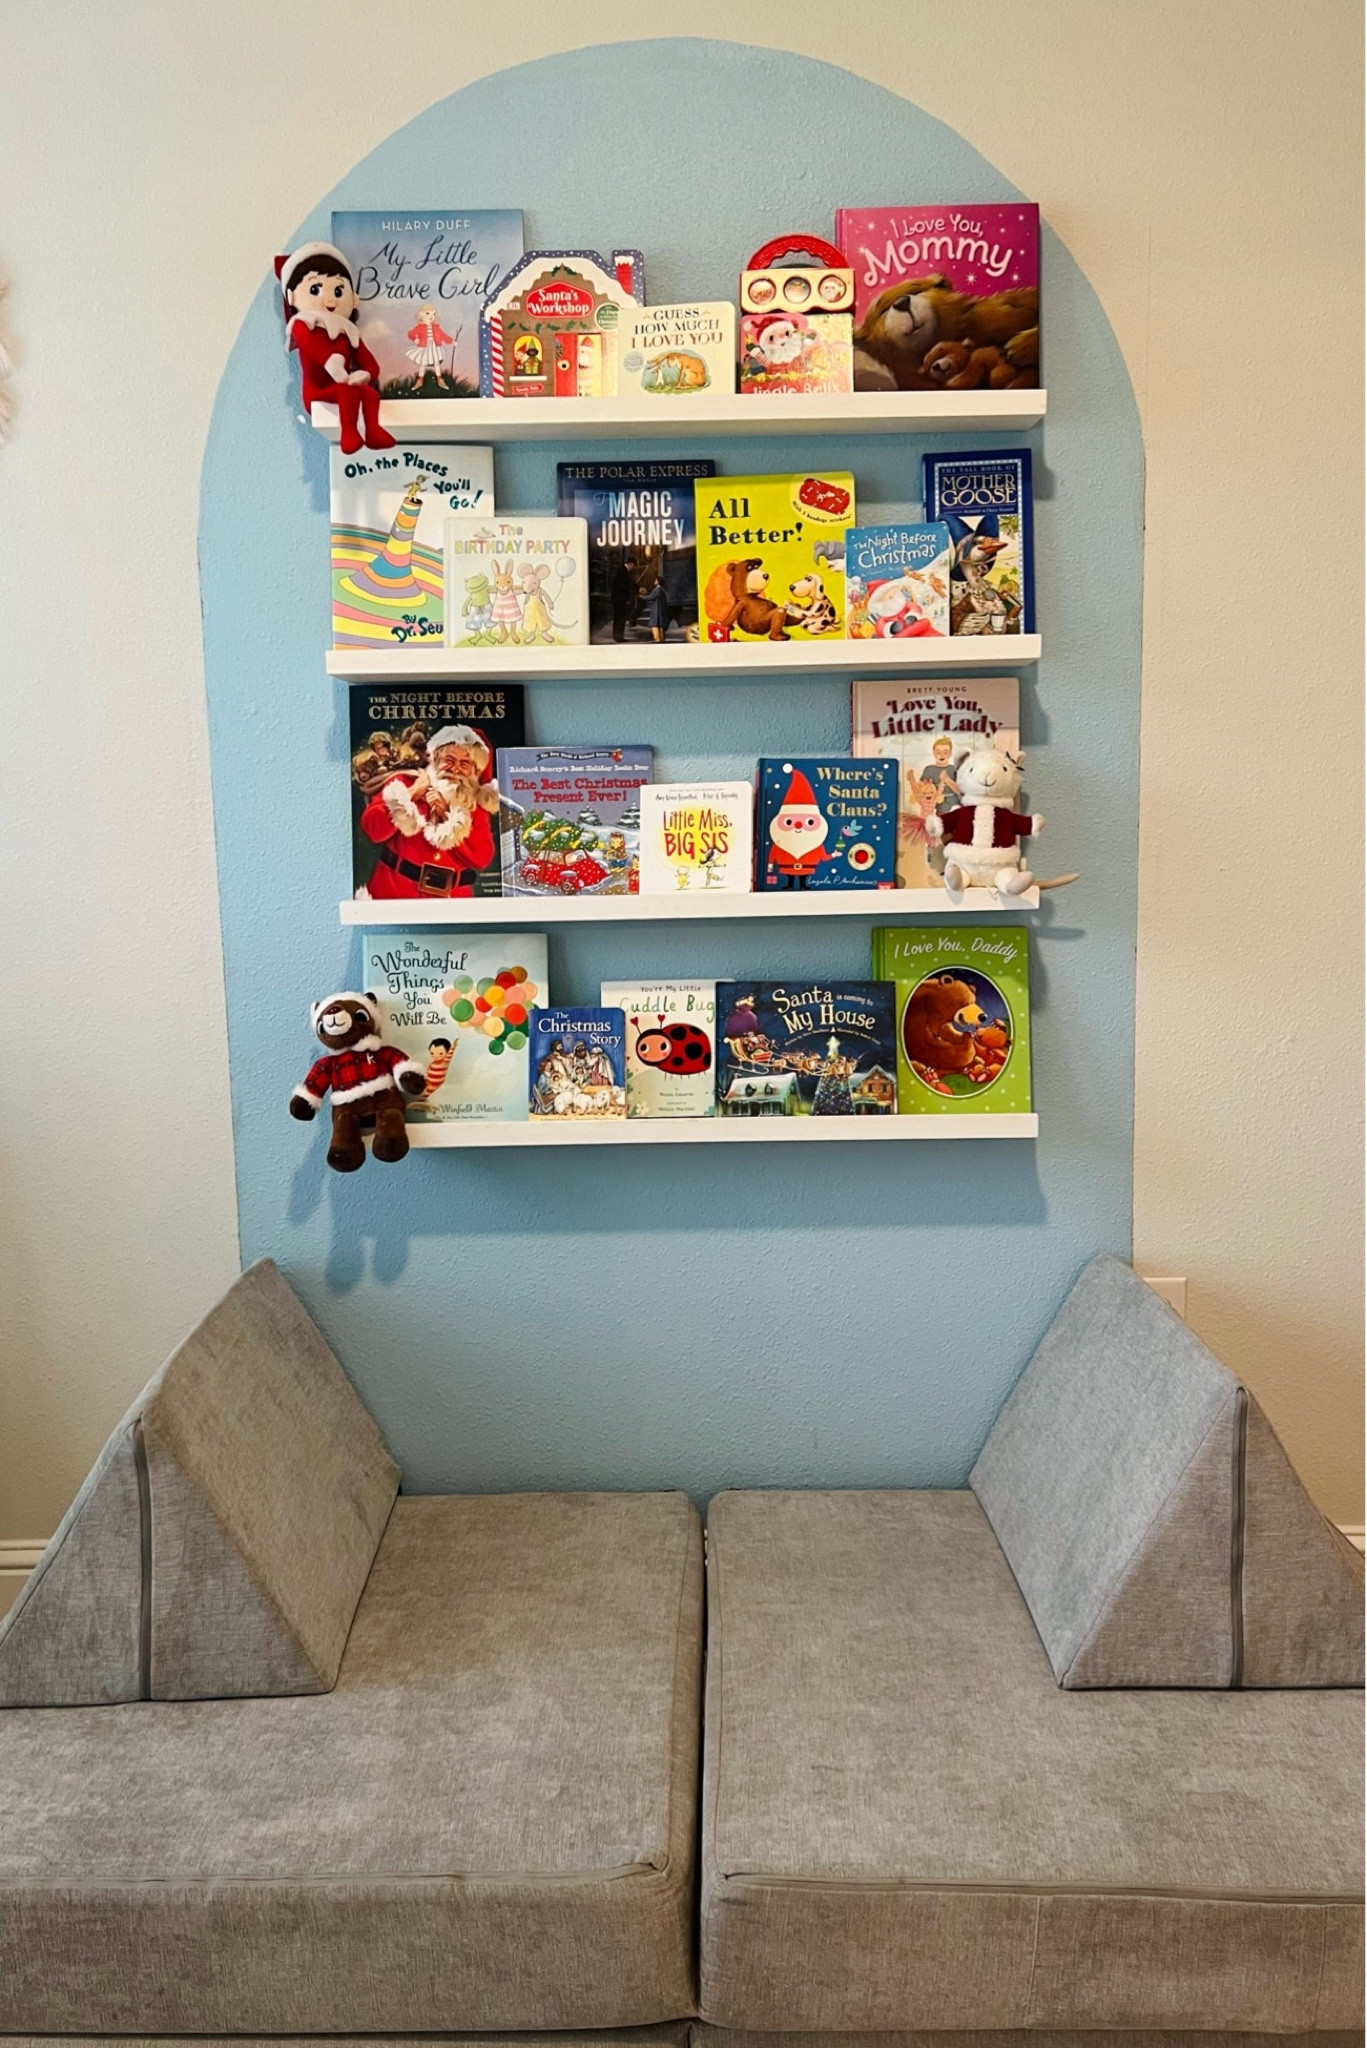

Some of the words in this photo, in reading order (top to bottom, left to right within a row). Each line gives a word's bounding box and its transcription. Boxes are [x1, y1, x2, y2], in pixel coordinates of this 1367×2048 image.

[381, 220, 431, 232] HILARY
[436, 219, 472, 231] DUFF
[890, 217, 899, 239] I
[902, 218, 947, 236] Love
[368, 241, 411, 282] My
[415, 234, 478, 270] Little
[863, 235, 1013, 288] Mommy
[356, 266, 431, 301] Brave
[439, 263, 500, 301] Girl
[538, 289, 579, 303] Santa's
[527, 301, 591, 317] Workshop
[653, 307, 700, 321] GUESS
[634, 321, 669, 335] HOW
[674, 318, 720, 332] MUCH
[630, 336, 637, 349] I
[642, 333, 685, 349] LOVE
[689, 331, 723, 346] YOU
[374, 456, 400, 472] the
[402, 452, 449, 477] Places
[564, 466, 596, 479] THE
[599, 465, 647, 479] POLAR
[649, 464, 710, 478] EXPRESS
[941, 473, 1016, 492] MOTHER
[449, 489, 484, 510] Go!
[608, 490, 673, 519] MAGIC
[940, 488, 1018, 507] GOOSE
[708, 497, 751, 519] All
[596, 518, 686, 547] JOURNEY
[708, 521, 804, 546] Better!
[867, 531, 899, 551] Night
[900, 532, 938, 546] Before
[453, 539, 524, 555] BIRTHDAY
[525, 539, 572, 555] PARTY
[857, 543, 937, 569] Christmas
[417, 616, 445, 637] Seu
[390, 691, 442, 704] NIGHT
[445, 691, 506, 703] BEFORE
[906, 686, 933, 694] BRETT
[937, 685, 967, 694] YOUNG
[367, 703, 507, 720] CHRISTMAS
[885, 698, 937, 715] Love
[871, 713, 936, 739] Little
[937, 713, 1004, 739] Lady
[511, 779, 538, 791] The
[540, 777, 572, 791] Best
[574, 776, 649, 790] Christmas
[816, 766, 884, 782] Where's
[533, 790, 584, 804] Present
[587, 788, 628, 802] Ever!
[828, 783, 881, 800] Santa
[825, 801, 888, 818] Claus?
[663, 810, 696, 832] Little
[664, 831, 696, 860] BIG
[699, 830, 730, 855] SIS
[404, 940, 421, 953] The
[902, 941, 935, 958] Love
[971, 936, 1019, 965] Daddy
[370, 948, 469, 975] Wonderful
[386, 970, 446, 995] Things
[665, 984, 677, 995] My
[678, 984, 702, 993] Little
[402, 990, 433, 1011] You
[619, 994, 678, 1014] Cuddle
[685, 993, 716, 1024] Bug
[771, 984, 835, 1015] Santa
[389, 1011, 425, 1028] Will
[425, 1010, 448, 1025] Be
[555, 1010, 570, 1020] The
[782, 1009, 814, 1035] My
[819, 1002, 877, 1031] House
[537, 1017, 612, 1033] Christmas
[588, 1032, 622, 1049] Story
